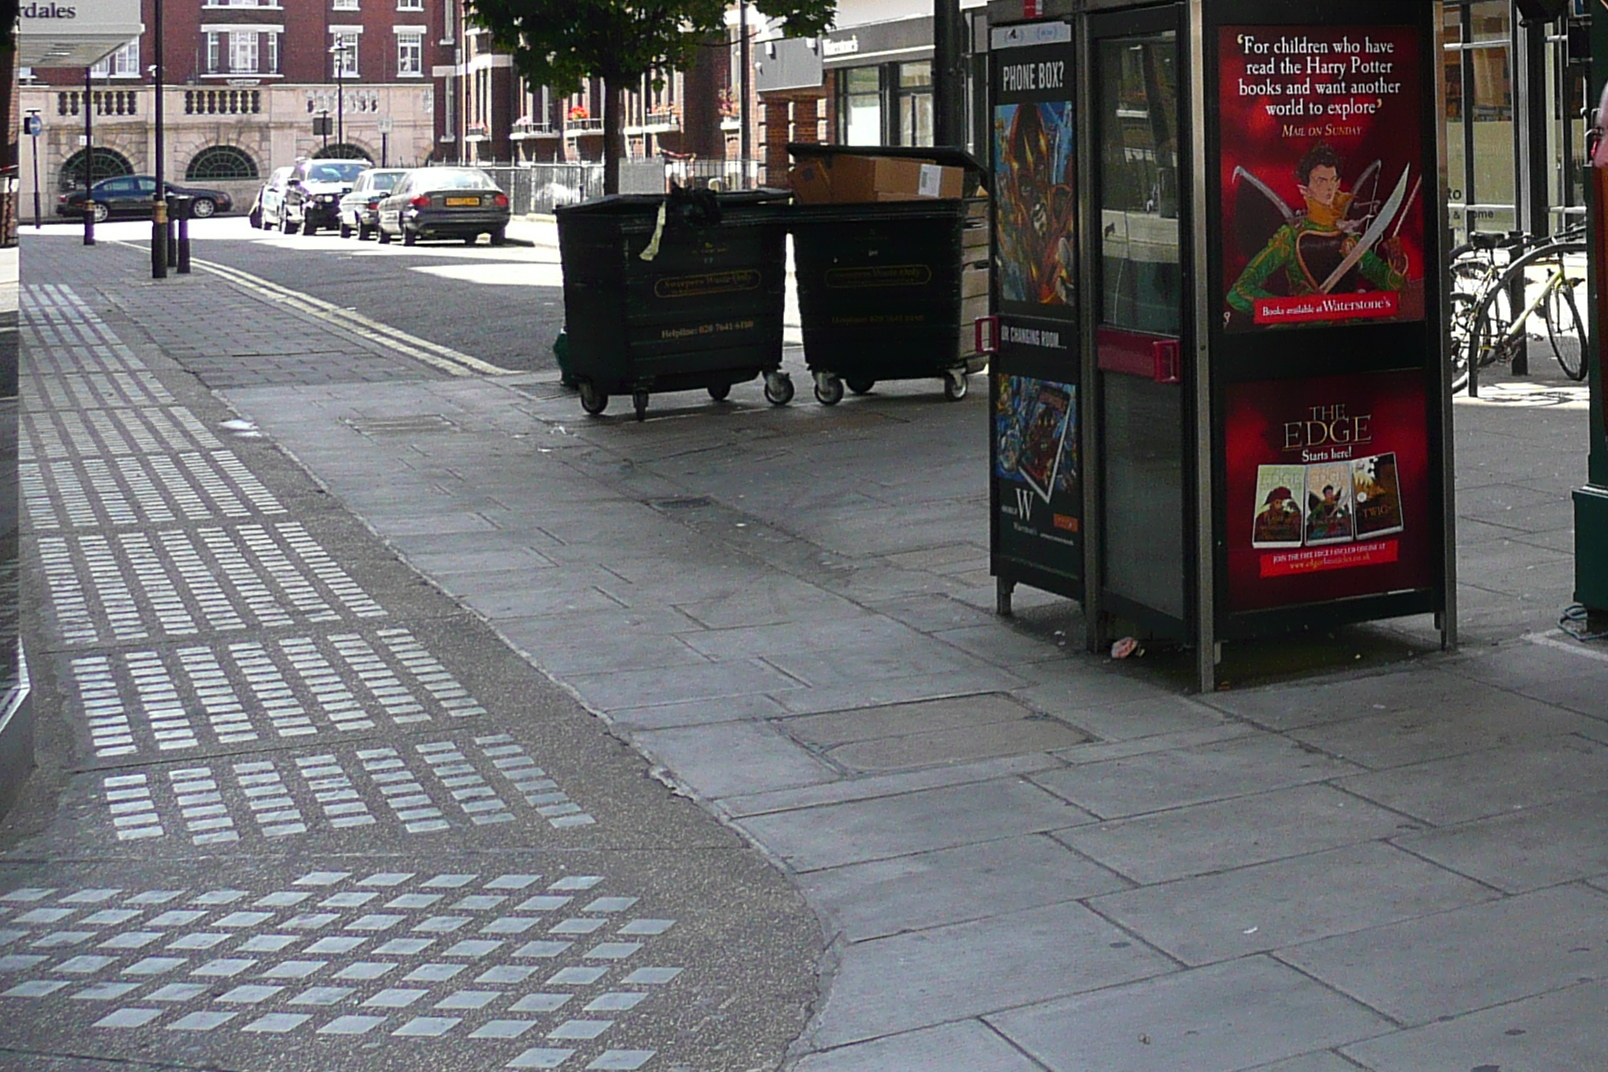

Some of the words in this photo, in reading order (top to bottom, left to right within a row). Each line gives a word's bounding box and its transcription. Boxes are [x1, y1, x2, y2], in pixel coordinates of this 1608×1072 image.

[1273, 36, 1329, 54] children
[1332, 36, 1361, 53] who
[1365, 36, 1395, 53] have
[1003, 63, 1036, 92] PHONE
[1038, 60, 1065, 89] BOX?
[1246, 57, 1275, 75] read
[1280, 56, 1302, 75] the
[1306, 56, 1346, 80] Harry
[1350, 56, 1393, 74] Potter
[1238, 78, 1282, 96] books
[1286, 77, 1311, 95] and
[1315, 81, 1347, 95] want
[1350, 76, 1401, 94] another
[1265, 98, 1304, 116] world
[1308, 101, 1324, 115] to
[1282, 124, 1306, 138] MAIL
[1324, 123, 1362, 136] SUNDAY
[1262, 306, 1284, 316] Books
[1286, 304, 1315, 315] available
[1316, 305, 1323, 313] at
[1322, 297, 1391, 313] Waterstone's
[1010, 327, 1040, 346] CHANGING
[1309, 404, 1348, 422] THE
[1284, 414, 1372, 448] EDGE
[1301, 448, 1329, 463] Starts
[1331, 446, 1352, 460] here!
[1015, 488, 1035, 522] W
[1362, 505, 1388, 518] TWIG
